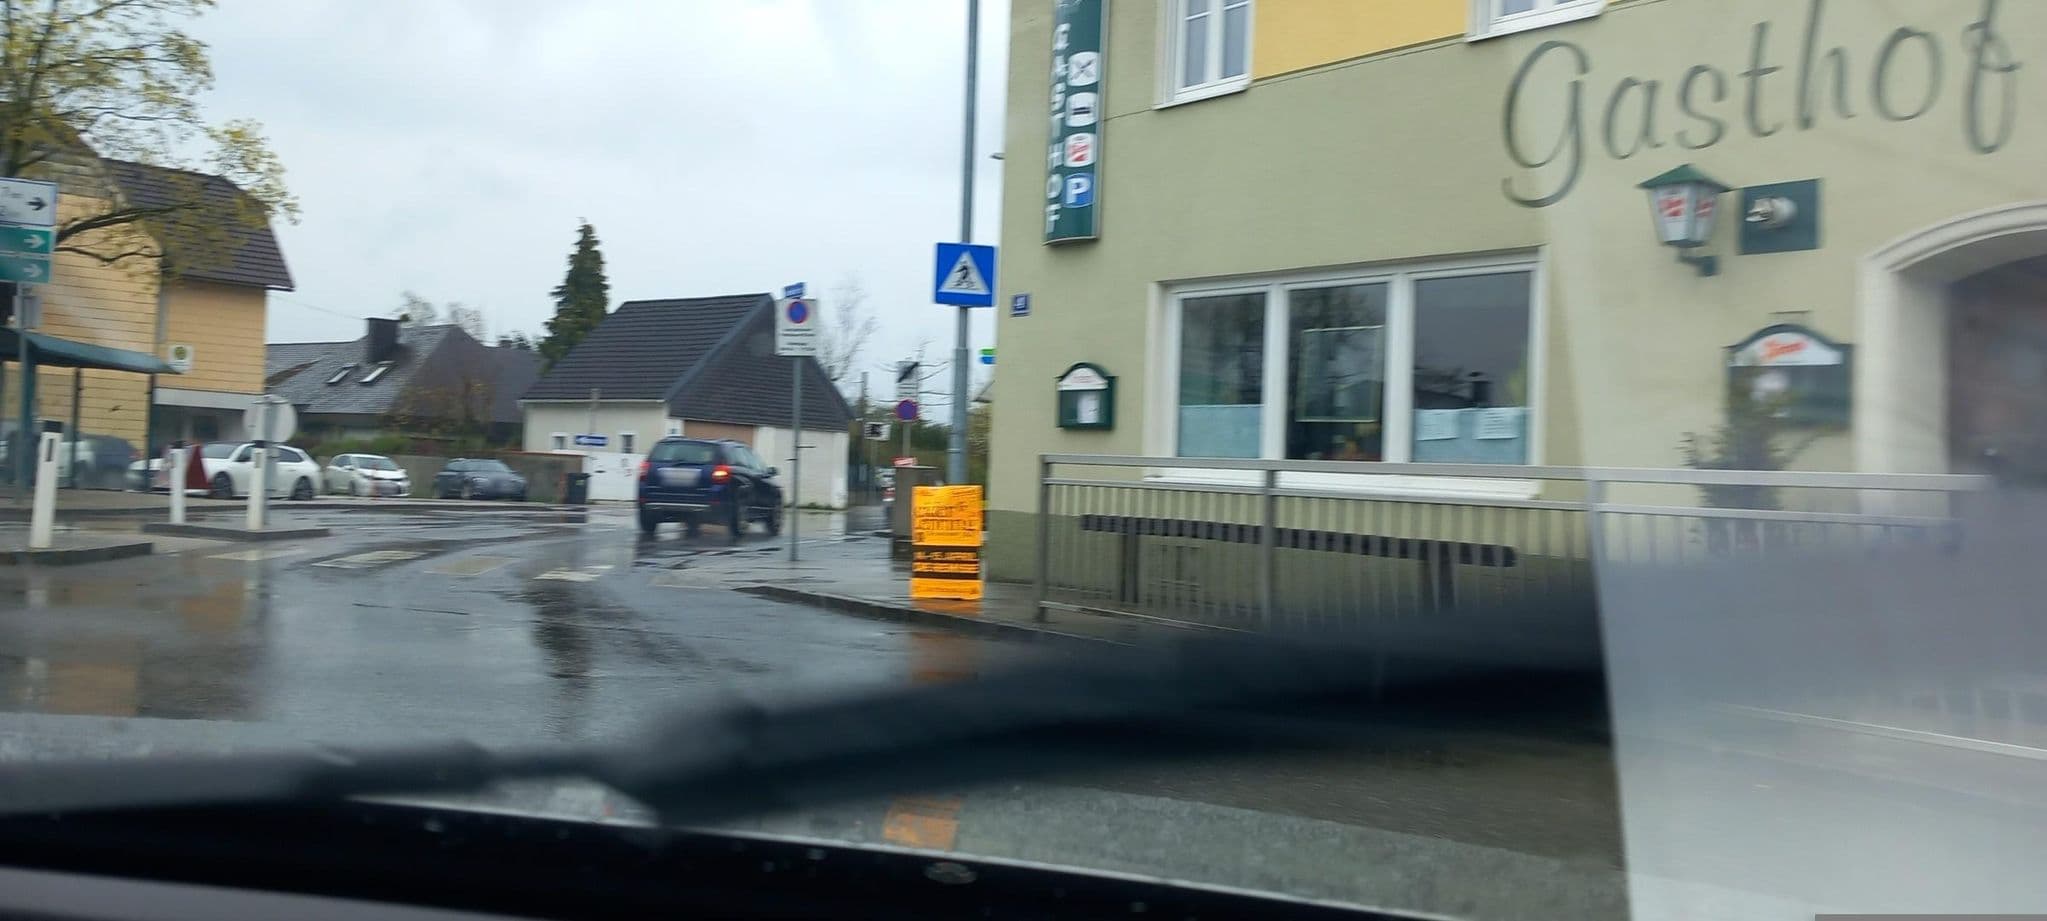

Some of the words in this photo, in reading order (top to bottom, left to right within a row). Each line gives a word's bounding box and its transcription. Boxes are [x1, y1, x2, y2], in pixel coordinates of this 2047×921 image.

[1045, 22, 1072, 235] GASTHOF
[1065, 178, 1092, 205] P
[1501, 0, 2021, 208] Gasthof
